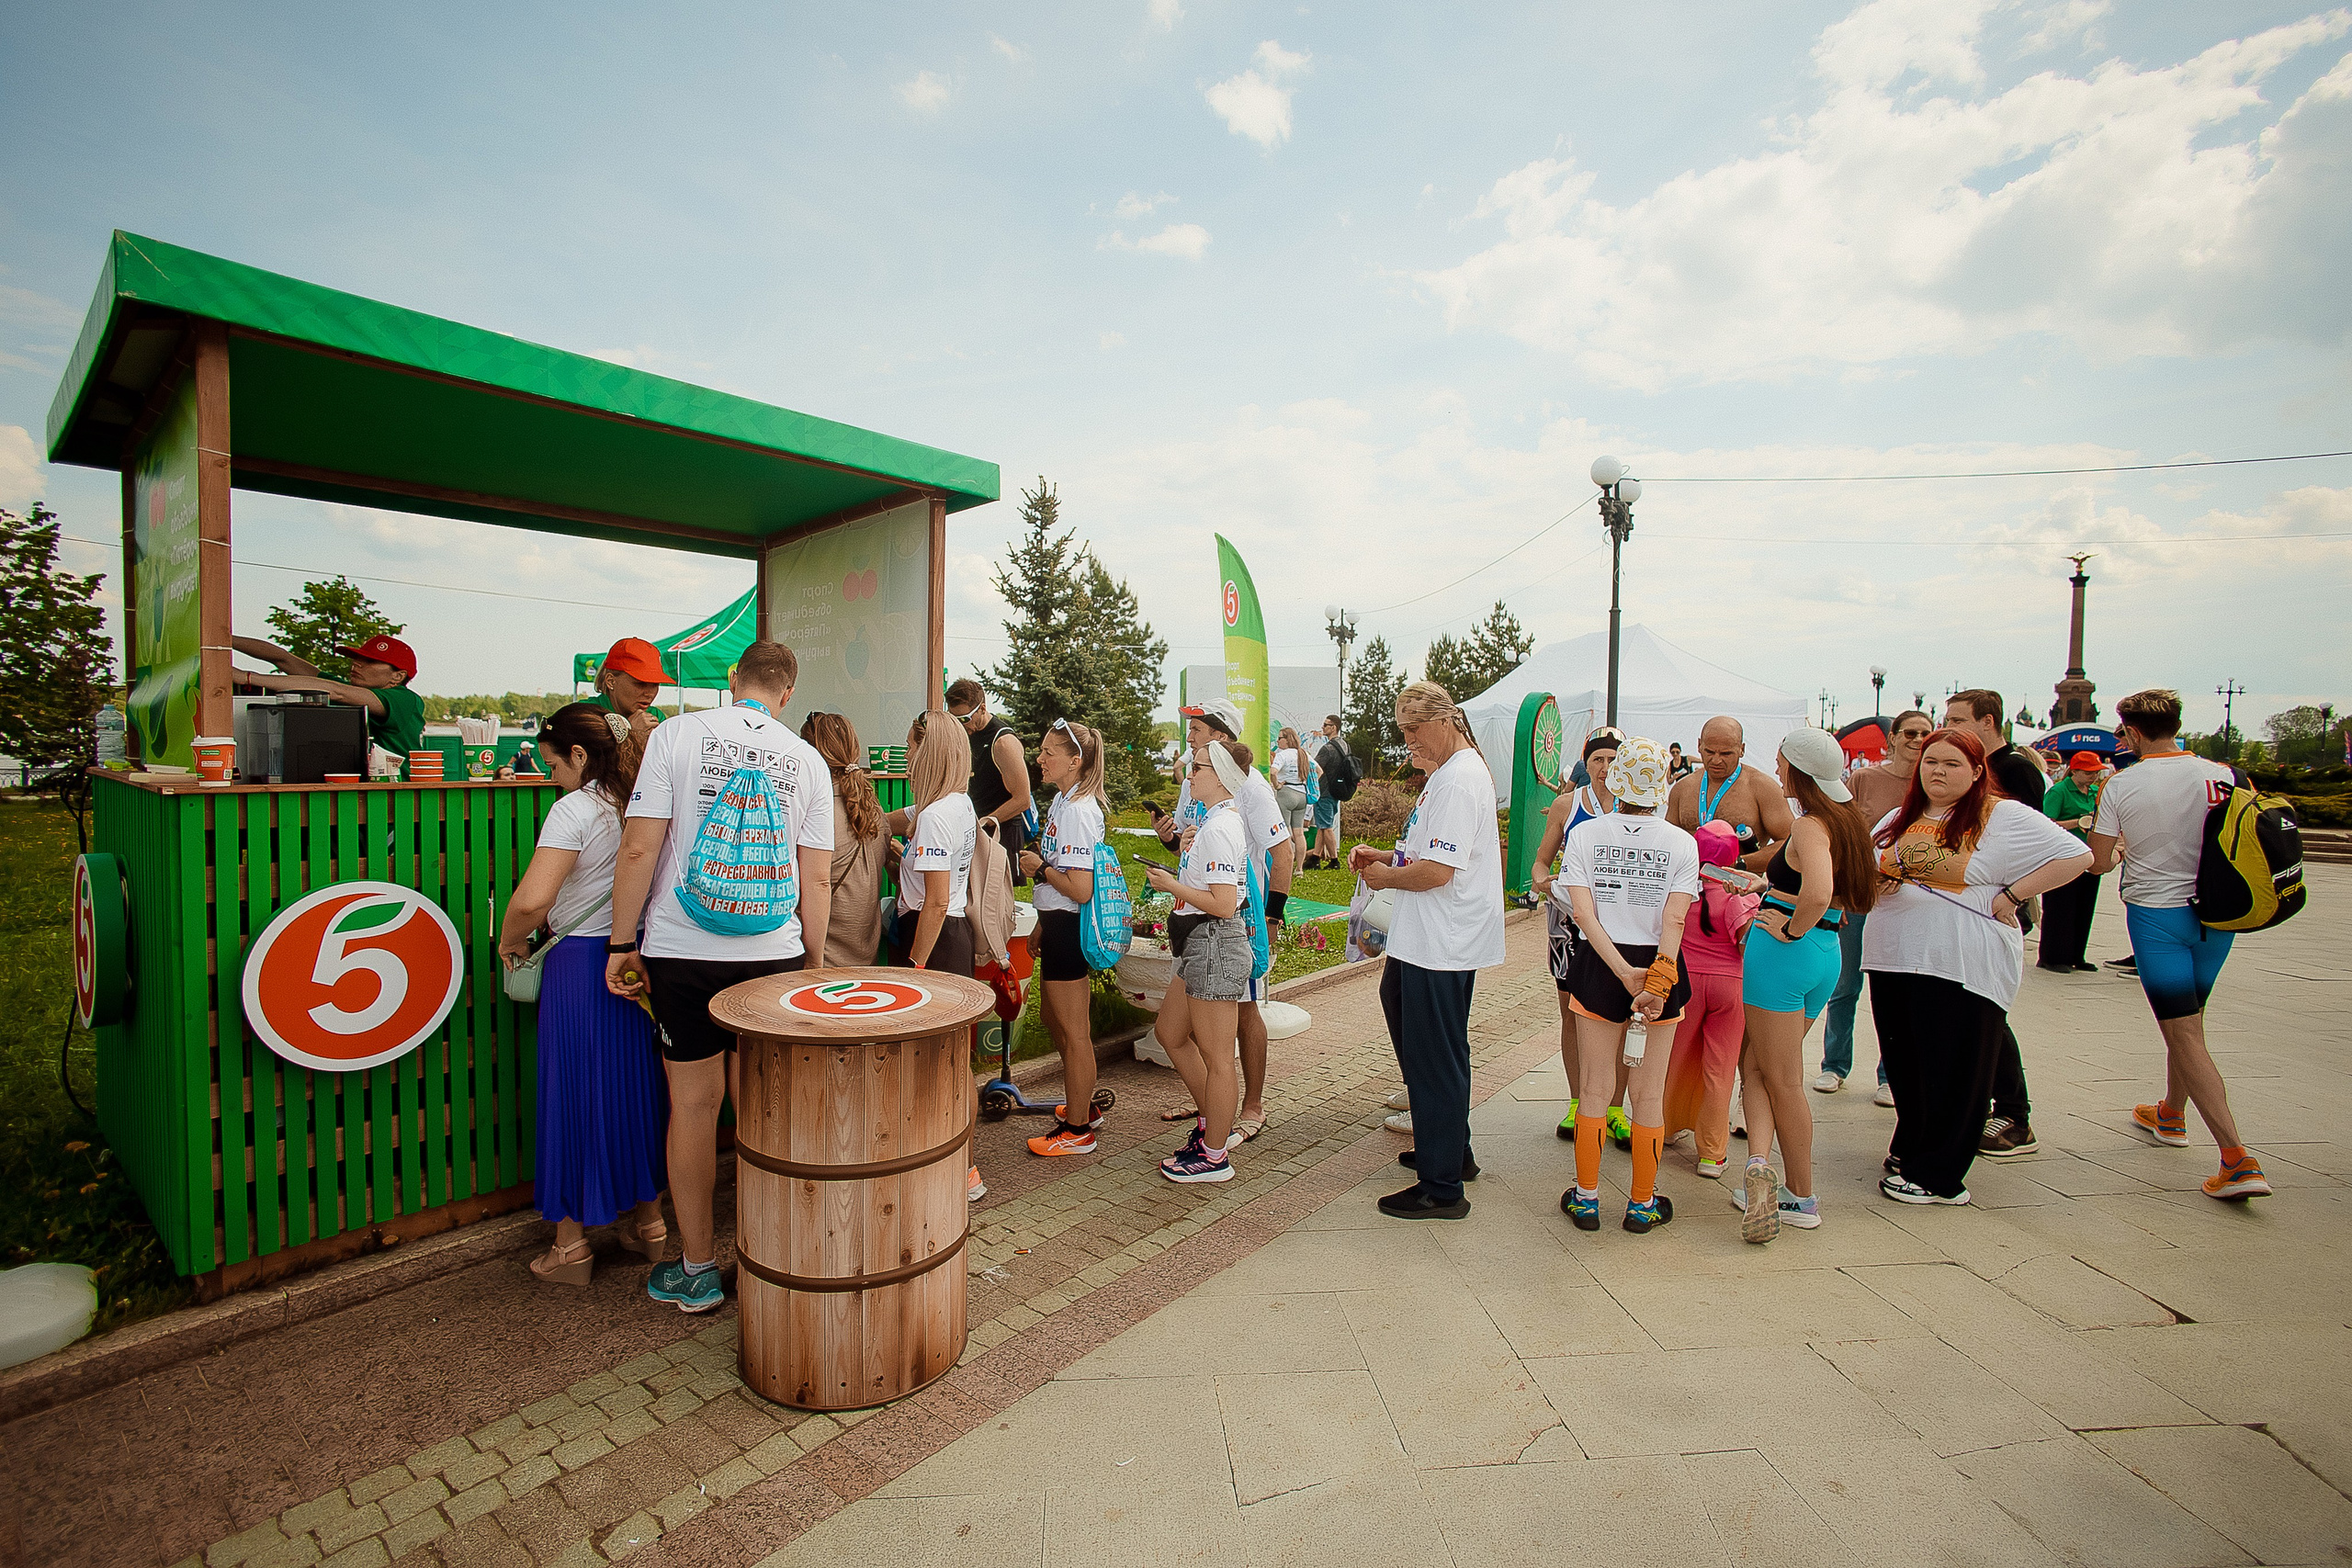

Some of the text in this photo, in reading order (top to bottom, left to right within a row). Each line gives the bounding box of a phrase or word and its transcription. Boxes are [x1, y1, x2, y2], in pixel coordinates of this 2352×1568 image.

[2082, 735, 2101, 743] ПСБ
[1072, 846, 1091, 856] ПСБ
[1436, 840, 1456, 852] ПСБ
[926, 847, 948, 857] ПСБ
[1594, 866, 1618, 874] ЛЮБИ
[1646, 871, 1667, 879] СЕБЕ
